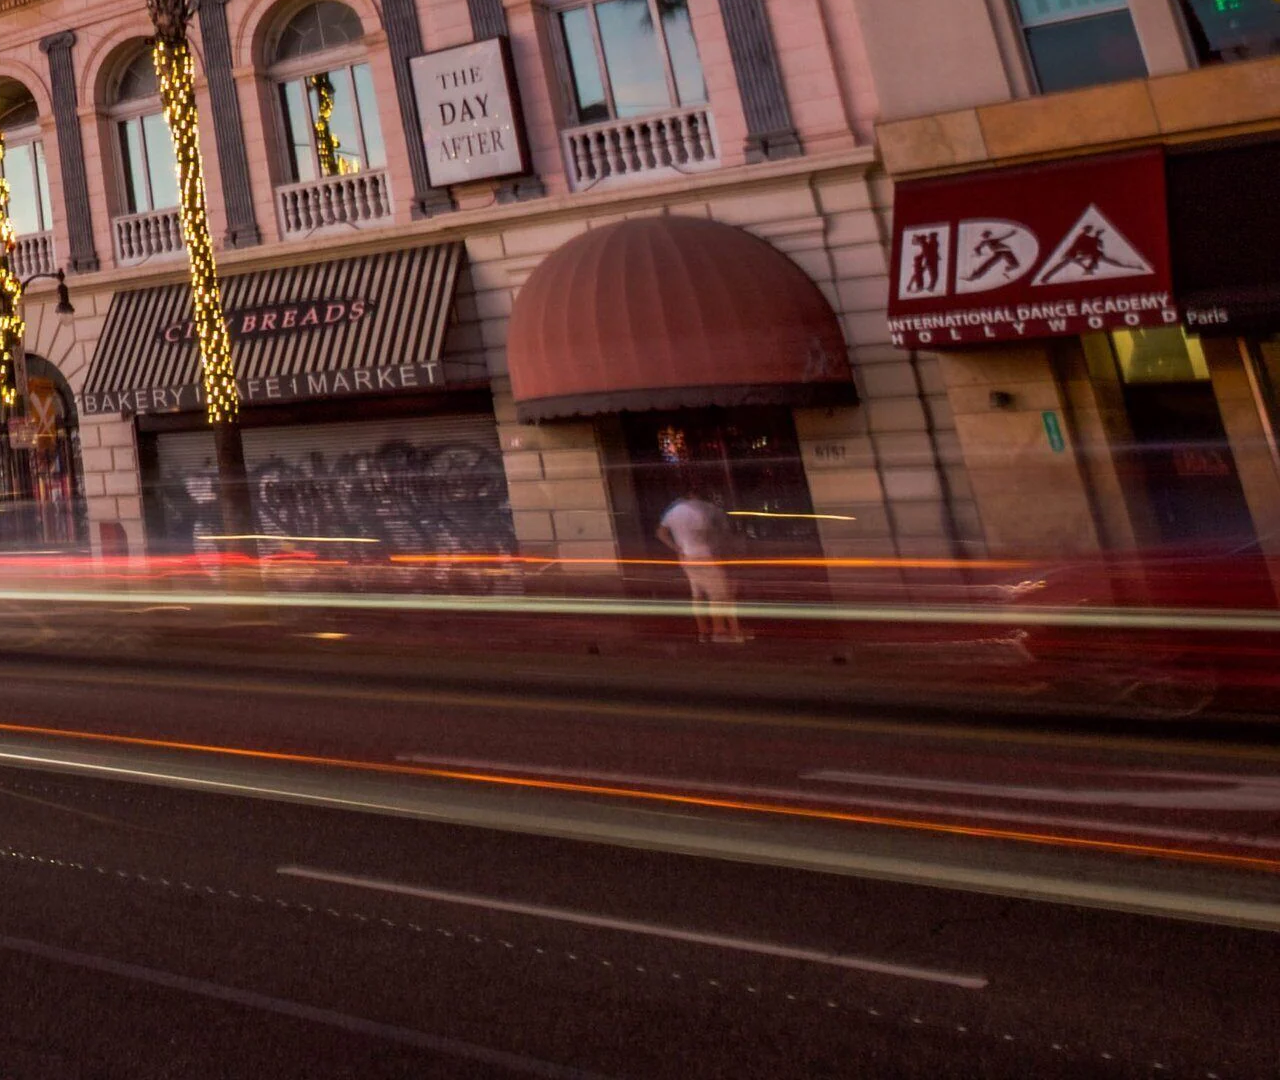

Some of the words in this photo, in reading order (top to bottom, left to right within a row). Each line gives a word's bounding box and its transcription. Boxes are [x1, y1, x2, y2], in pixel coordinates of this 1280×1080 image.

[436, 66, 483, 91] THE
[438, 93, 489, 127] DAY
[439, 129, 506, 163] AFTER
[898, 202, 1156, 301] IDA
[240, 300, 366, 335] BREADS
[887, 309, 1017, 334] INTERNATIONAL
[1017, 302, 1078, 322] DANCE
[1080, 293, 1171, 317] ACADEMY
[890, 309, 1178, 347] HOLLYWOOD
[1186, 307, 1229, 326] Paris
[85, 389, 184, 414] BAKERY
[305, 363, 439, 396] MARKET
